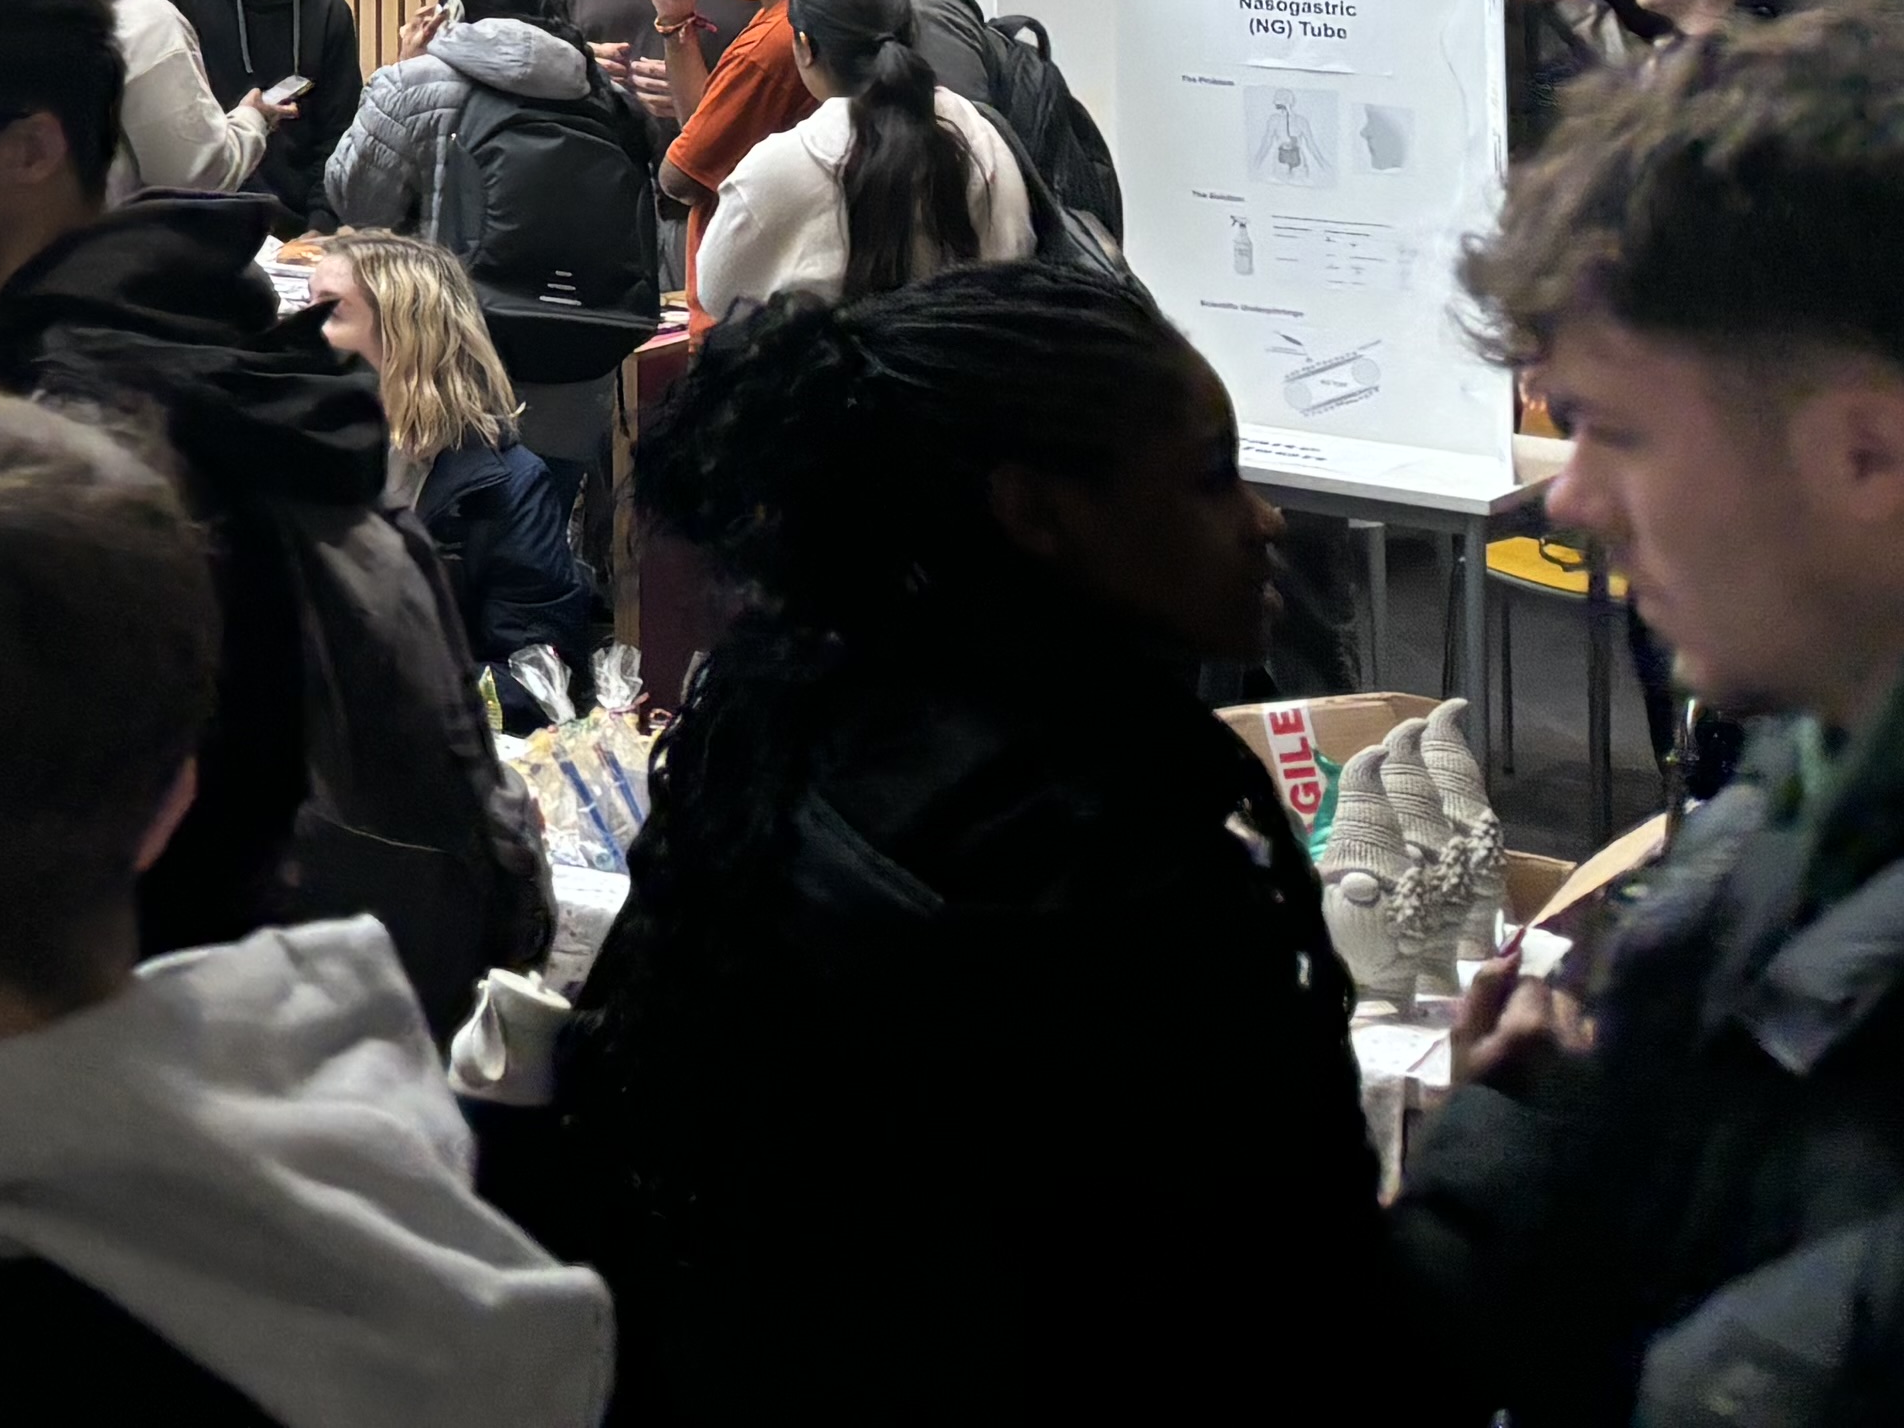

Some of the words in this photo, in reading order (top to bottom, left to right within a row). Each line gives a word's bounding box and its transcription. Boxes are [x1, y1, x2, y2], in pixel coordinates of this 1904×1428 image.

[1248, 16, 1293, 40] (NG)
[1298, 19, 1348, 40] Tube
[1269, 707, 1322, 824] GILE
